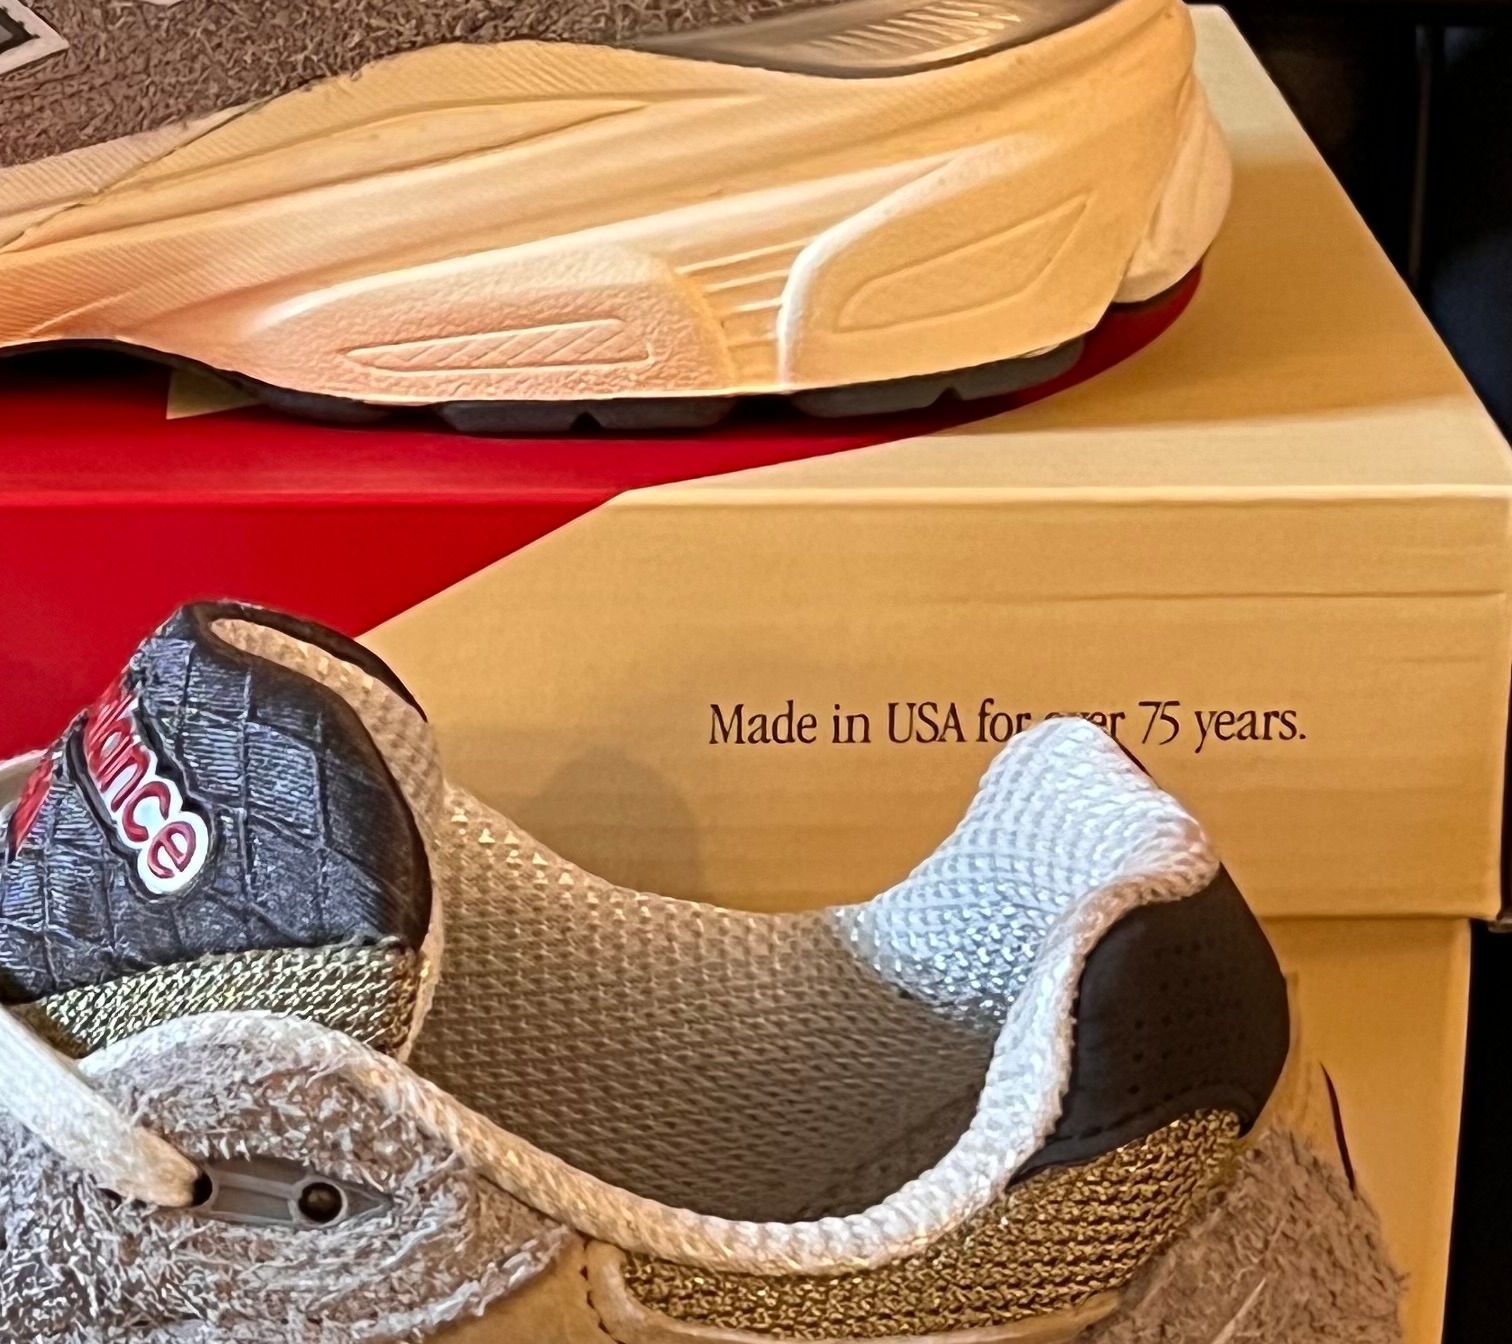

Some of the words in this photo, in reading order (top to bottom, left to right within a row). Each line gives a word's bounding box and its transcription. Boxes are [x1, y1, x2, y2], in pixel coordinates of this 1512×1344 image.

[708, 699, 818, 744] Made
[831, 703, 871, 744] in
[887, 701, 966, 744] USA
[975, 697, 1032, 743] for
[1044, 711, 1126, 739] er
[1138, 700, 1181, 745] 75
[1194, 709, 1307, 754] years.
